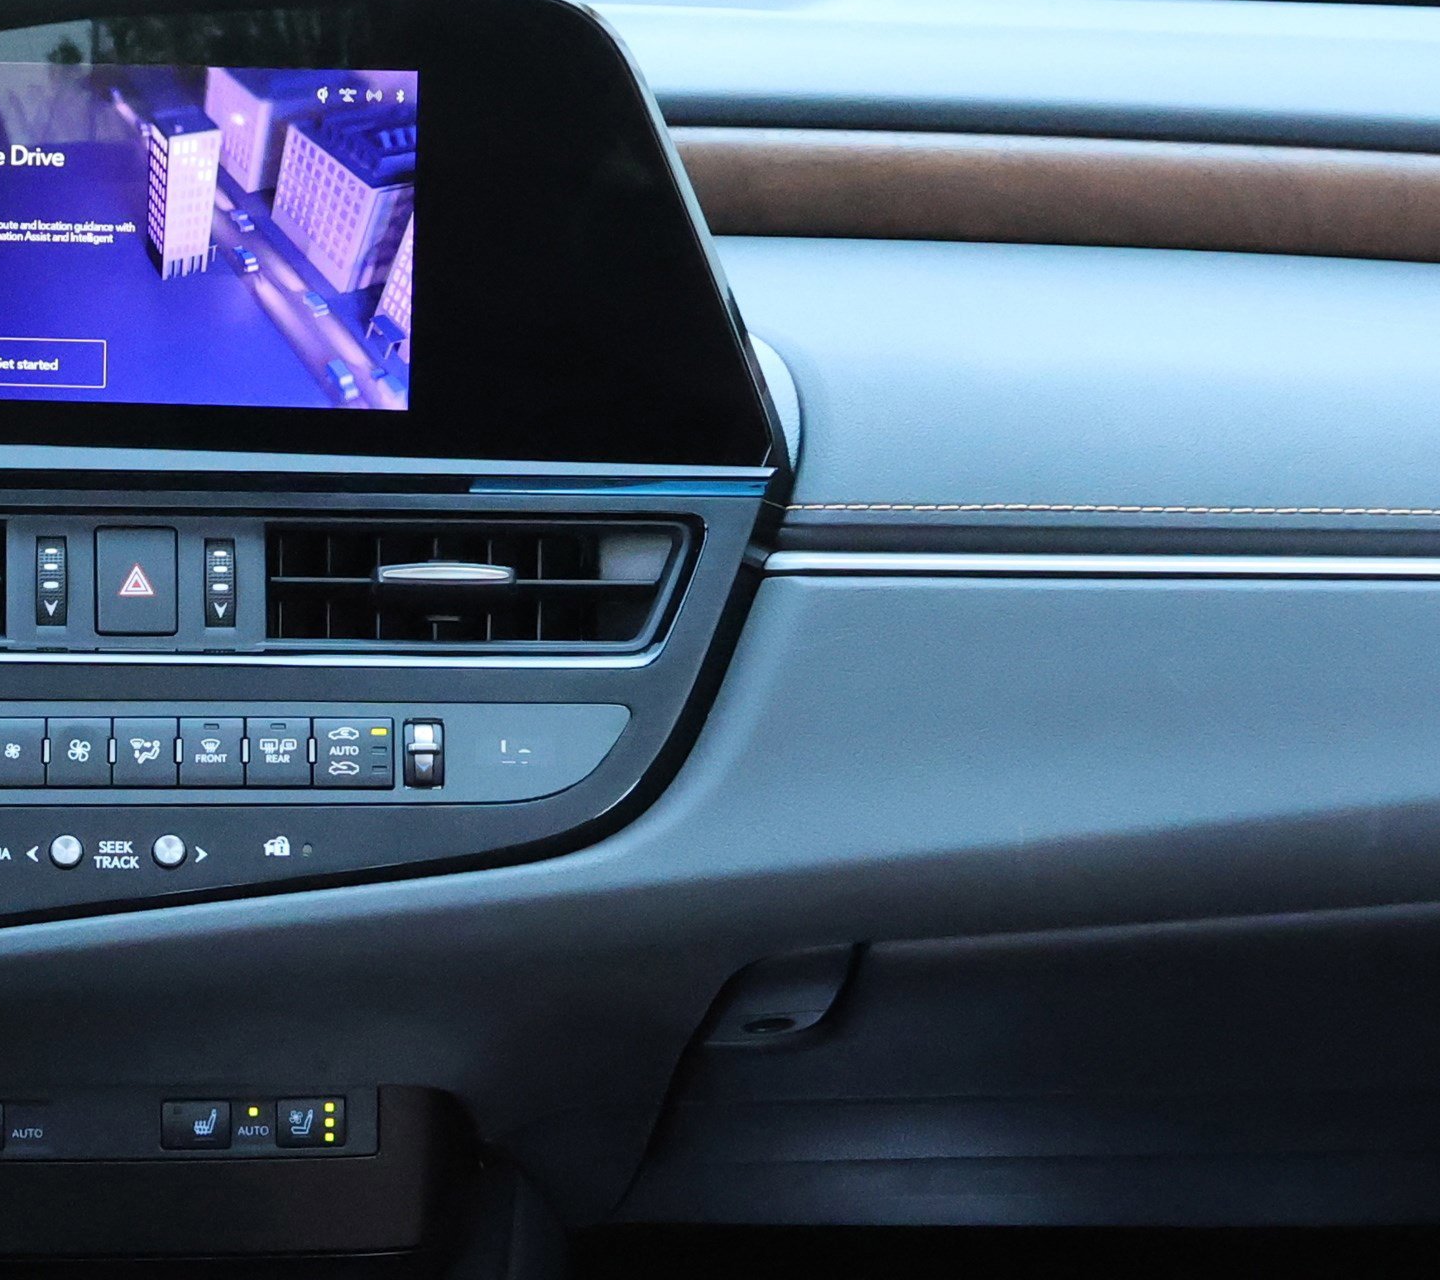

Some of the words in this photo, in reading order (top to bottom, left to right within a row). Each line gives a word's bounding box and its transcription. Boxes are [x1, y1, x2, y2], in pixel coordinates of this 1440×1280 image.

[10, 145, 65, 167] Drive
[19, 220, 38, 231] and
[38, 220, 73, 231] location
[73, 221, 114, 234] guidance
[115, 221, 136, 233] with
[24, 230, 52, 242] Assist
[52, 231, 70, 243] and
[70, 232, 114, 245] Intelligent
[22, 356, 59, 373] started
[329, 745, 359, 756] AUTO
[195, 753, 227, 764] FRONT
[265, 753, 291, 764] REAR
[98, 840, 133, 854] SEEK
[93, 855, 139, 869] TRACK
[12, 1128, 43, 1139] AUTO
[237, 1125, 270, 1136] AUTO
